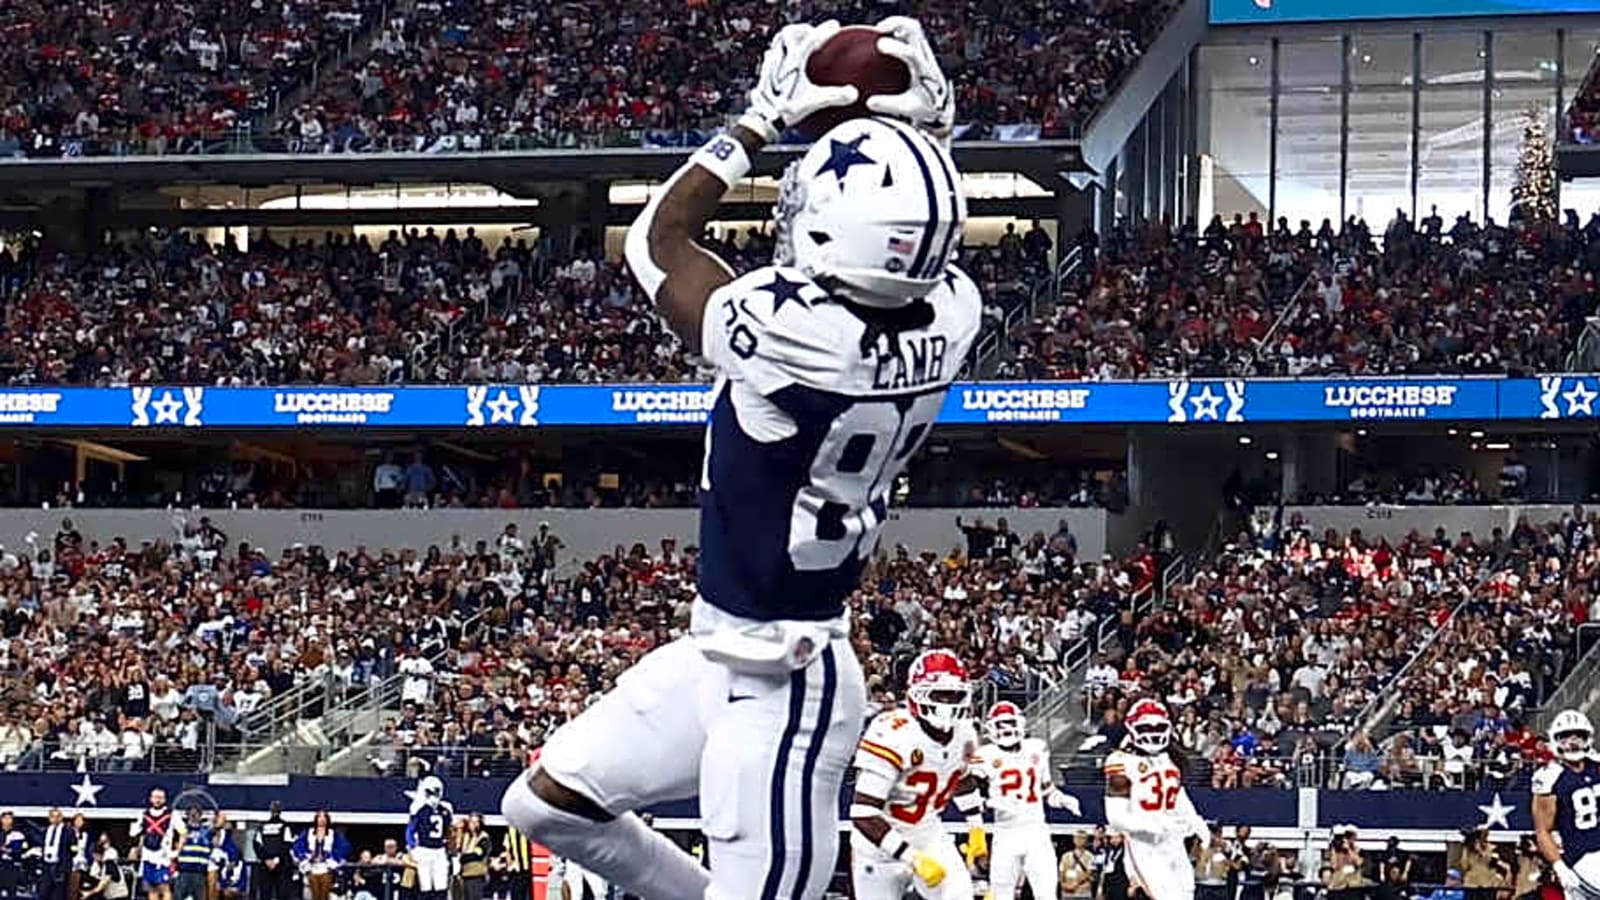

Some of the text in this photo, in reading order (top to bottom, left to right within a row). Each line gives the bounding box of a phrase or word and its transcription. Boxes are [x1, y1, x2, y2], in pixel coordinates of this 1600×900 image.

[872, 334, 947, 390] LAMB
[0, 392, 62, 412] HESE
[275, 392, 394, 412] LUCCHESE
[612, 391, 715, 411] LUCCHES
[963, 389, 1090, 409] LUCCHESE
[1325, 386, 1457, 406] LUCCHESE
[1350, 407, 1426, 418] BOOTMAKER
[1000, 767, 1038, 803] 21
[1140, 769, 1181, 811] 32
[429, 814, 443, 839] 3
